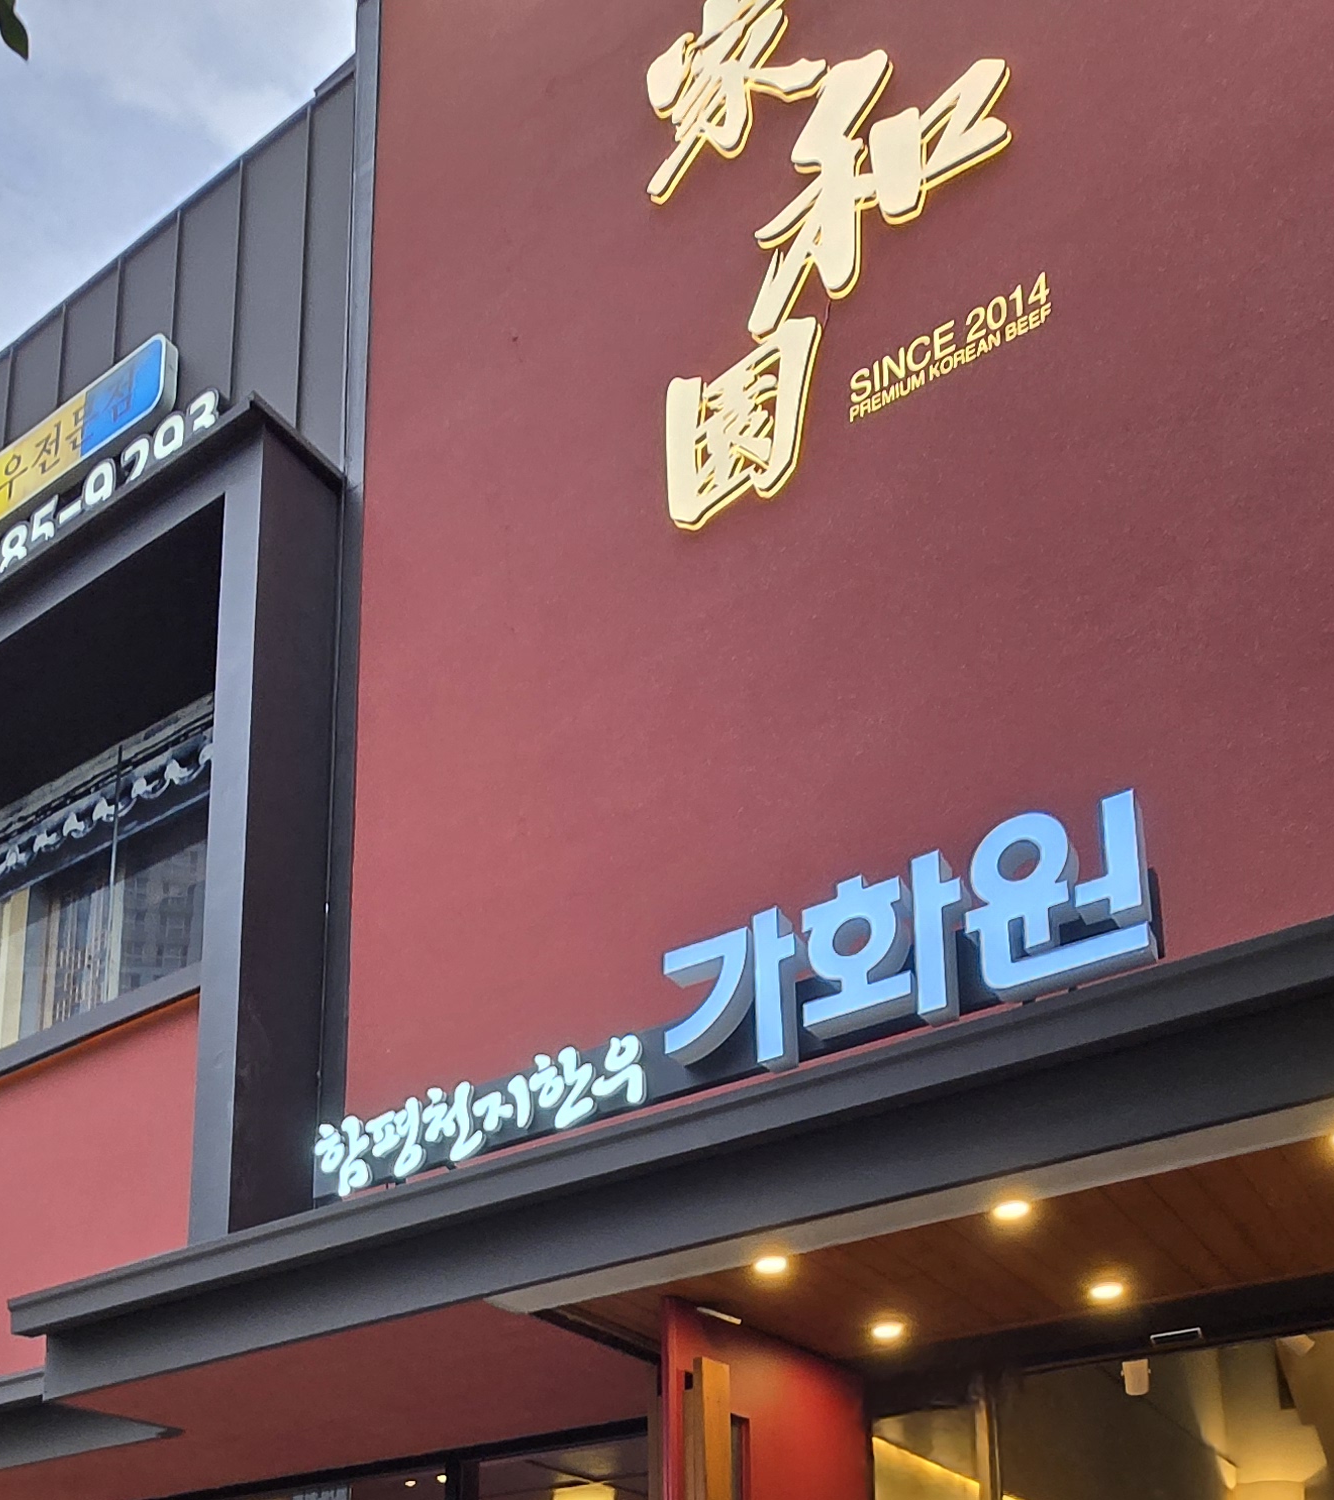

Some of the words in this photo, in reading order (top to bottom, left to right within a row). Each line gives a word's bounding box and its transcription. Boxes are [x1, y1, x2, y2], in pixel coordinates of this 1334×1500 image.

[848, 369, 926, 423] PREMIUM
[929, 329, 1002, 382] KOREAN
[1004, 301, 1053, 343] BEEF
[849, 319, 957, 404] SINCE
[965, 271, 1051, 344] 2014
[663, 788, 1157, 1068] 가화원
[315, 1032, 648, 1197] 함평천지한우
